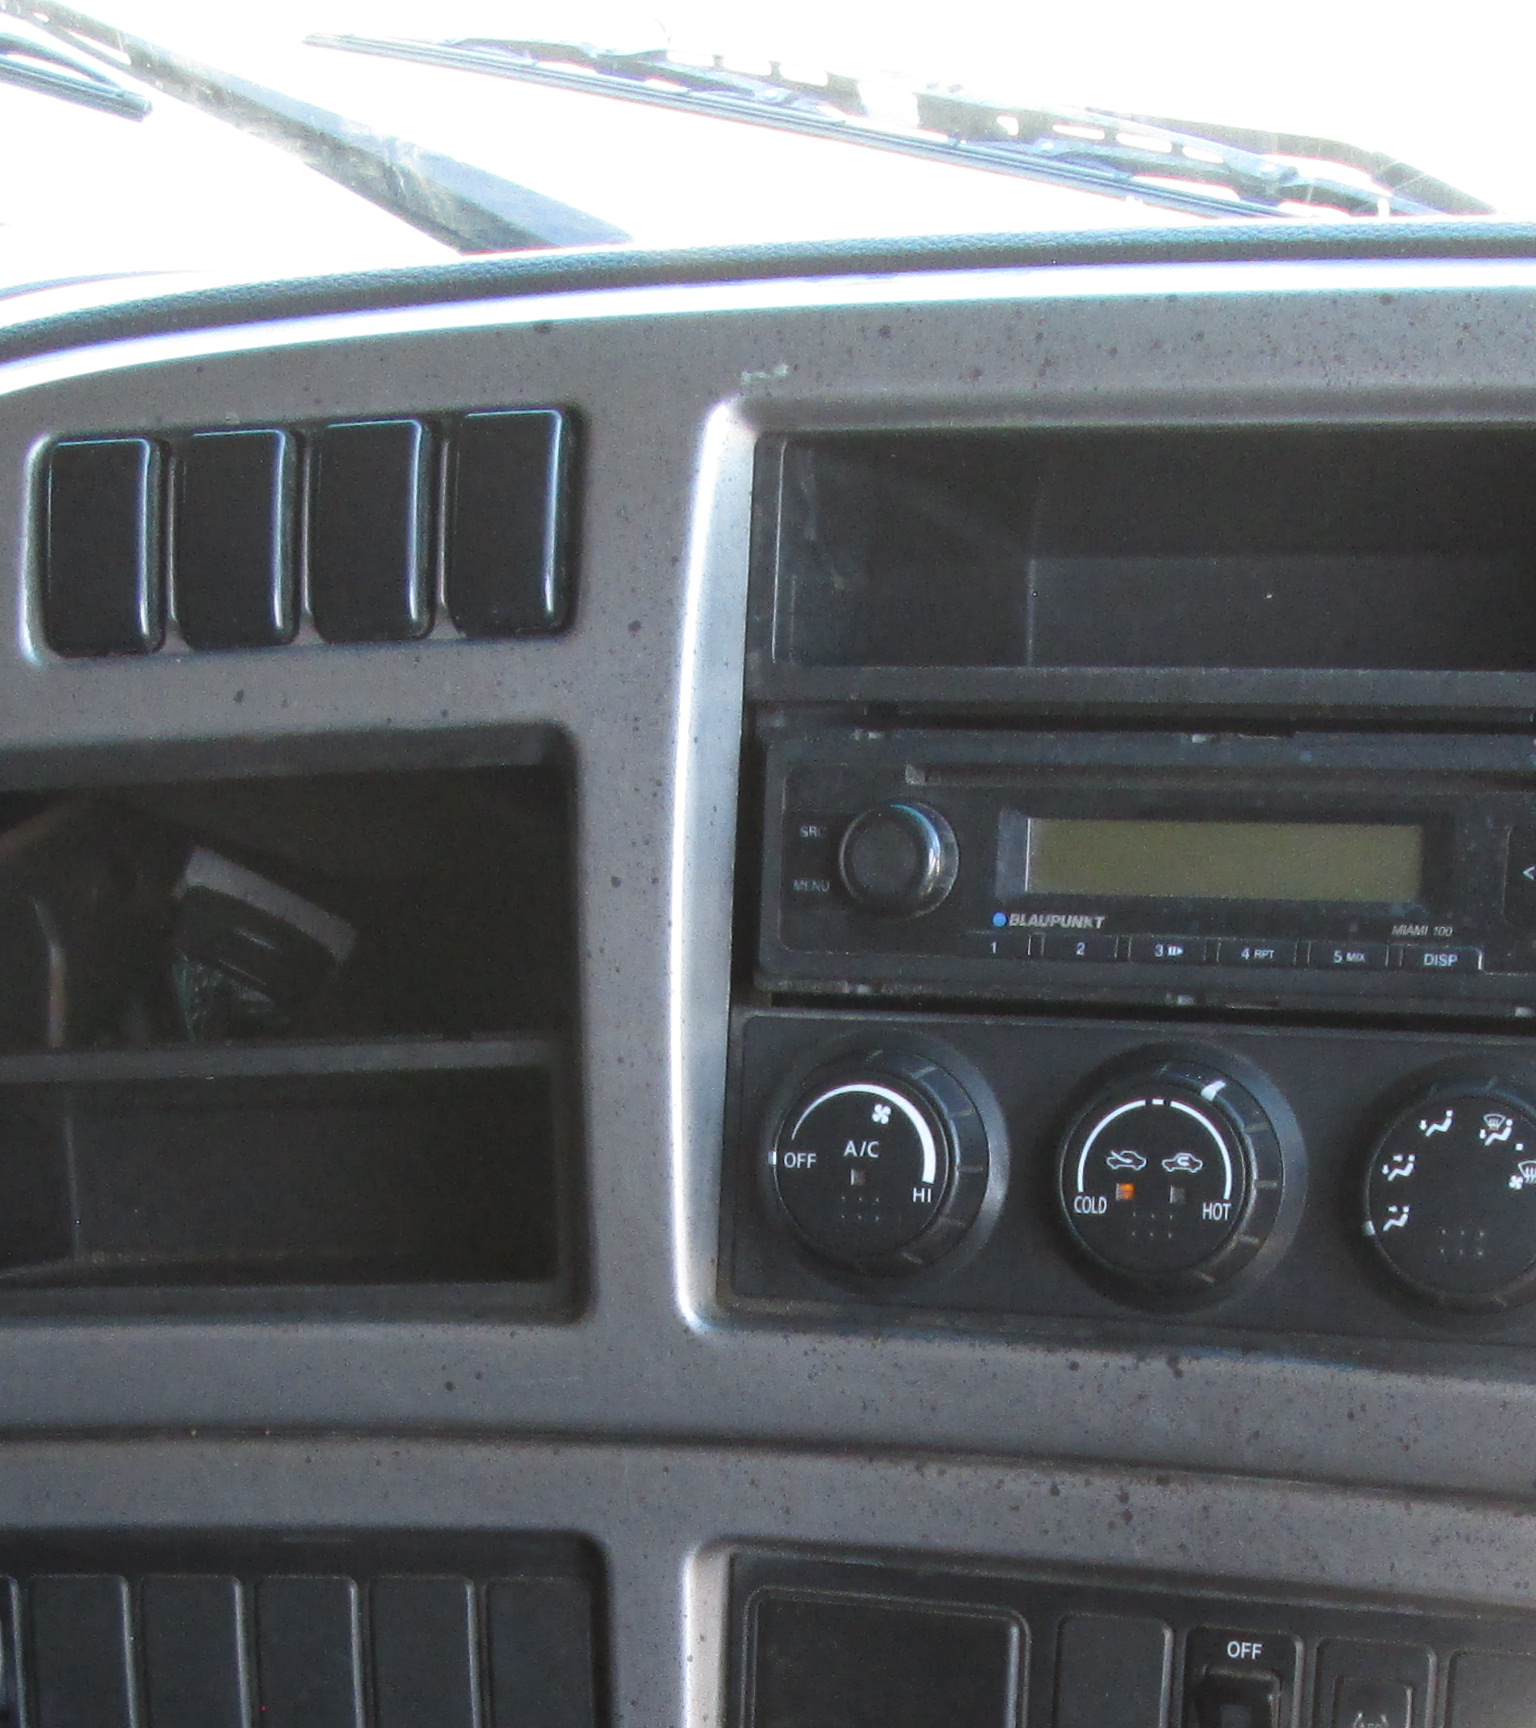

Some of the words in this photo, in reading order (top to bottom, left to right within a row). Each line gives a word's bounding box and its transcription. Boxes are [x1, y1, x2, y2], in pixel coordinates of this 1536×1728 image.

[793, 879, 830, 892] MENU
[1009, 913, 1106, 929] BLAUPUNKT
[1391, 924, 1429, 937] MIAMI
[1433, 926, 1453, 938] 100
[989, 942, 997, 954] 1
[1075, 942, 1085, 956] 2
[1154, 944, 1164, 957] 3
[1241, 947, 1250, 960] 4
[1333, 950, 1342, 964] 5
[1346, 951, 1366, 963] MIX
[1423, 953, 1458, 967] DISP
[843, 1140, 880, 1159] A/C
[783, 1152, 817, 1169] OFF
[912, 1187, 932, 1203] HI
[1073, 1196, 1108, 1214] COLD
[1202, 1202, 1232, 1221] HOT
[1227, 1641, 1262, 1660] OFF
